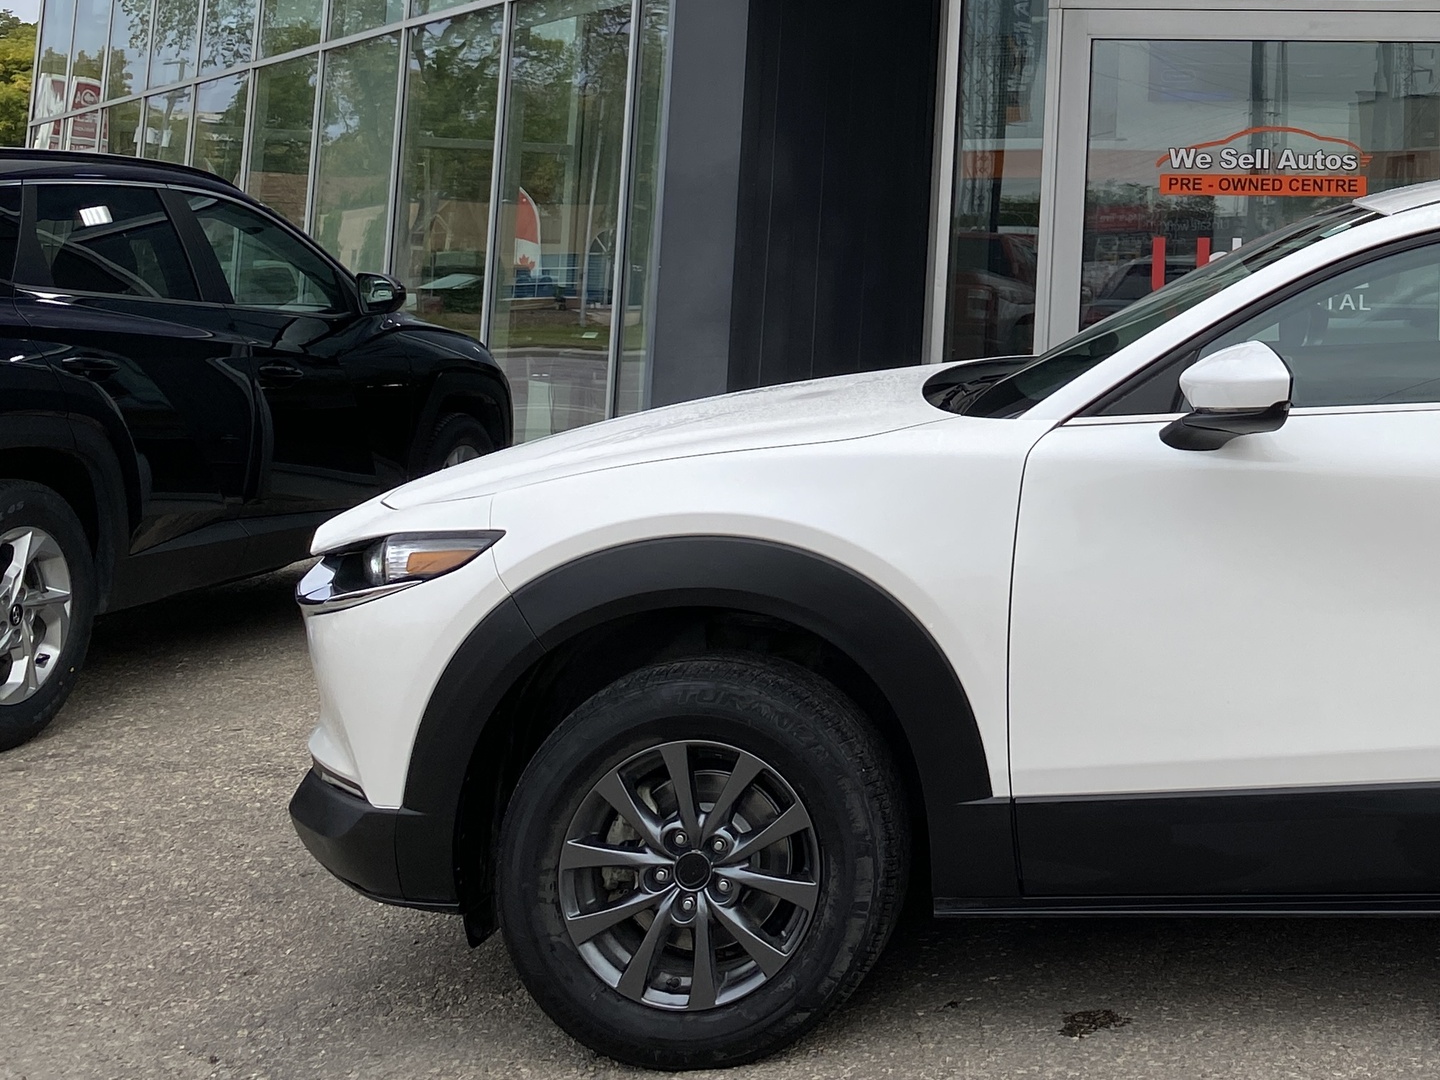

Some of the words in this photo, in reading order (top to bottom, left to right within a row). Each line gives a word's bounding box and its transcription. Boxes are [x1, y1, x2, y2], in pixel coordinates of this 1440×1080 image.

[1168, 147, 1213, 170] We
[1219, 147, 1270, 170] Sell
[1277, 148, 1359, 171] Autos
[1168, 177, 1203, 191] PRE
[1218, 177, 1283, 192] OWNED
[1288, 178, 1358, 193] CENTRE
